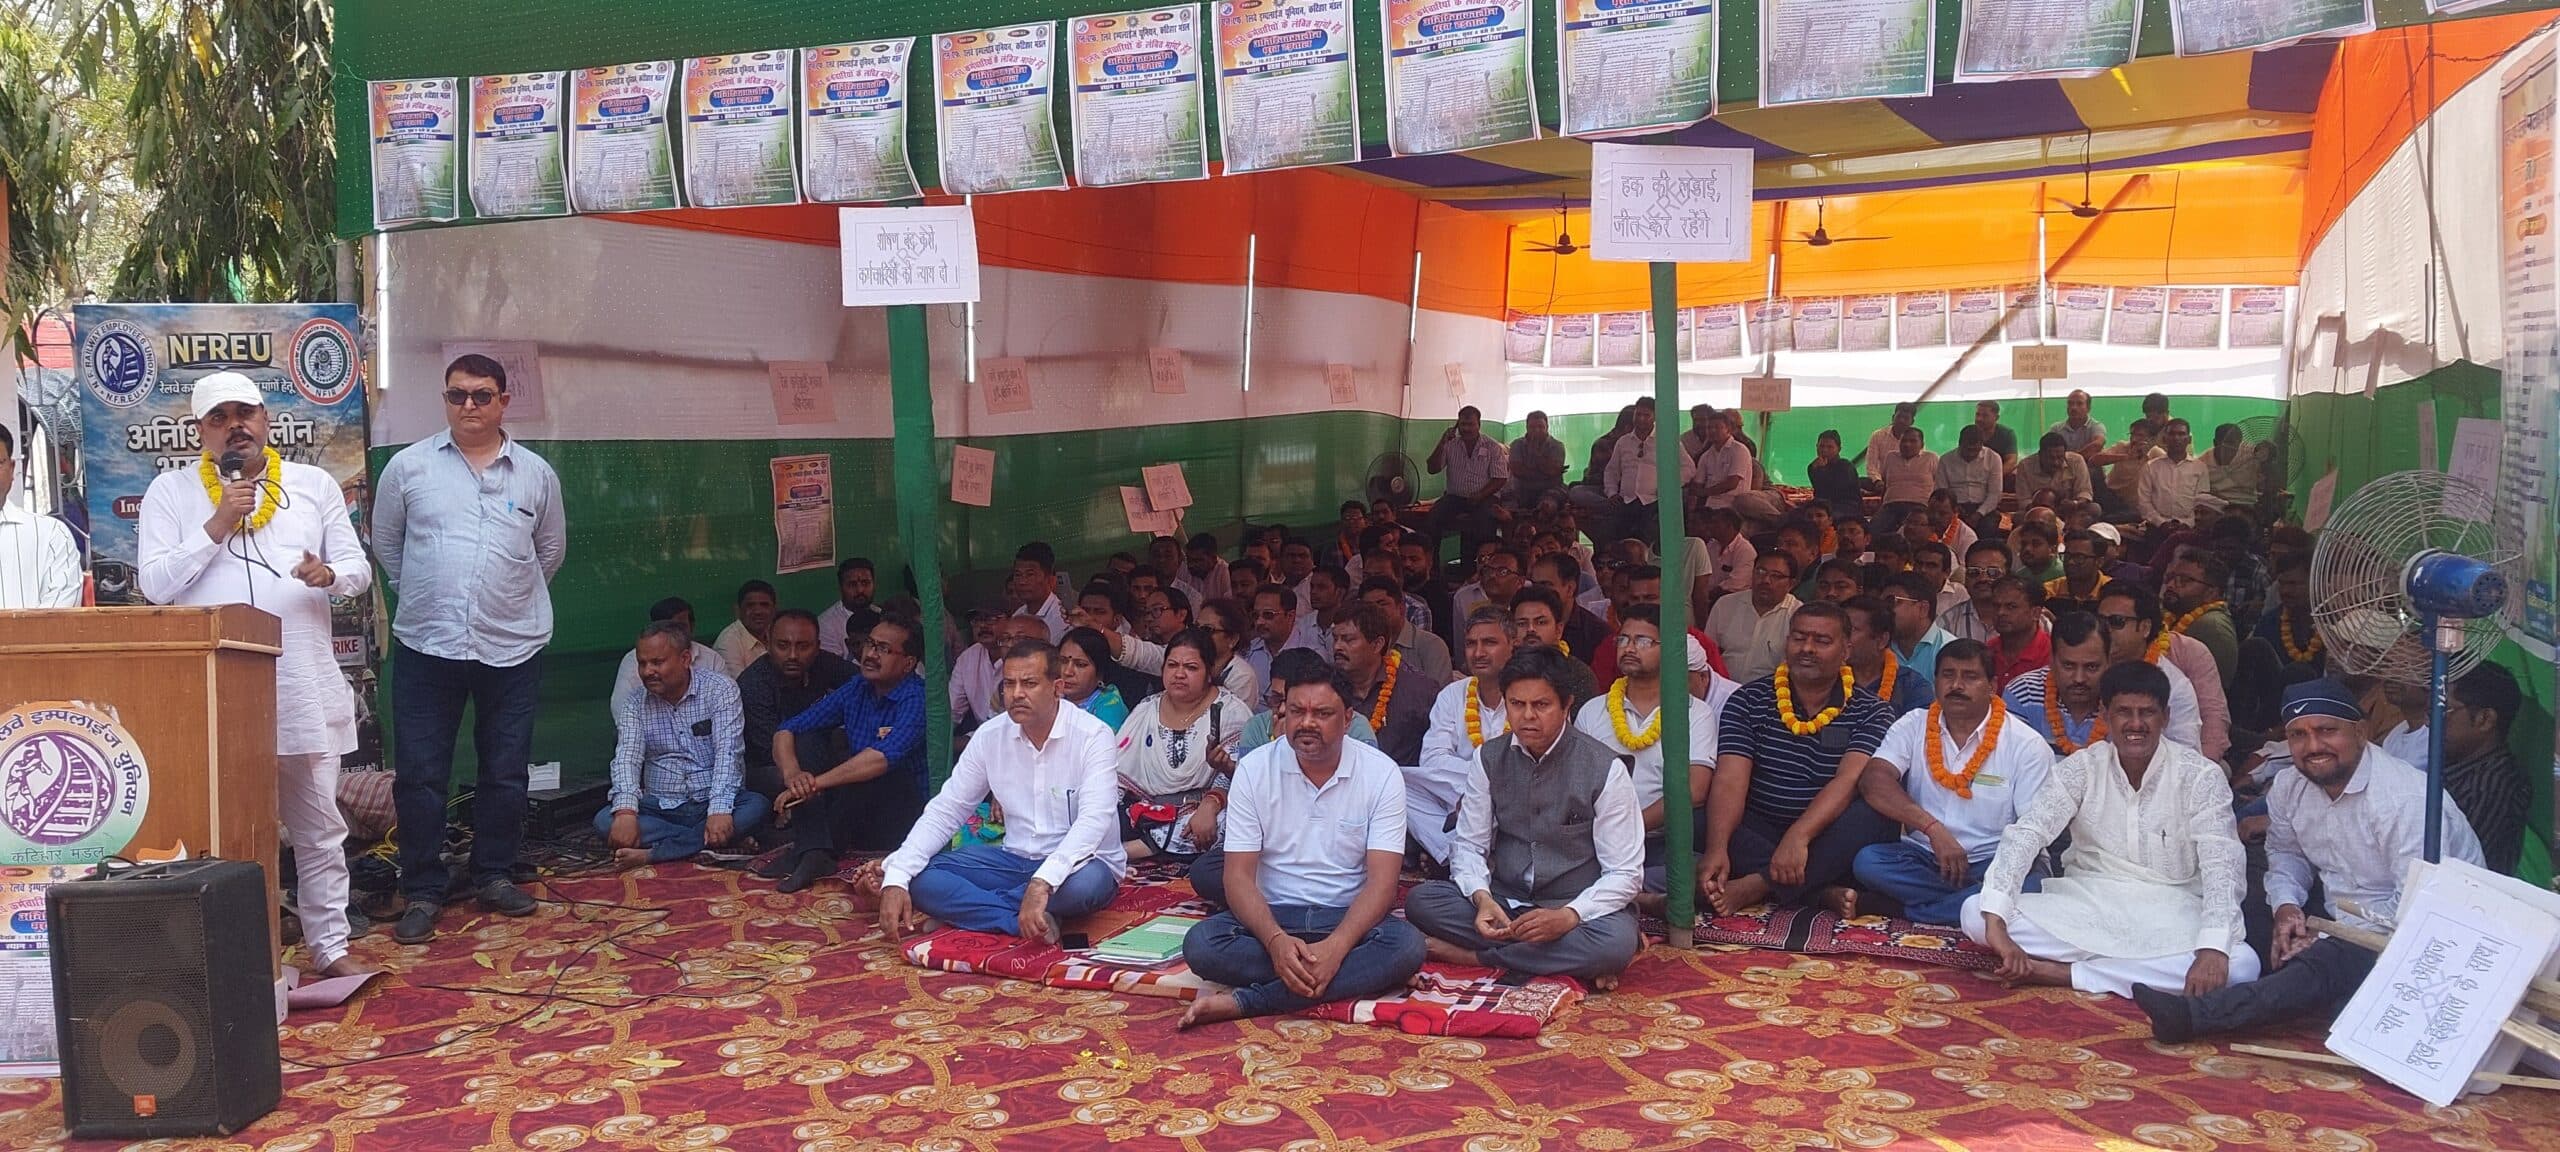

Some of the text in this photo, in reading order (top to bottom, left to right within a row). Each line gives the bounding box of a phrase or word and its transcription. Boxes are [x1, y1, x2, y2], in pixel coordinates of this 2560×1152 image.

[167, 333, 271, 365] NFREU
[145, 347, 154, 376] UNION
[160, 379, 179, 393] रेलवे
[333, 640, 359, 654] RIKE
[0, 714, 25, 742] लवे
[11, 848, 62, 865] कटिहार
